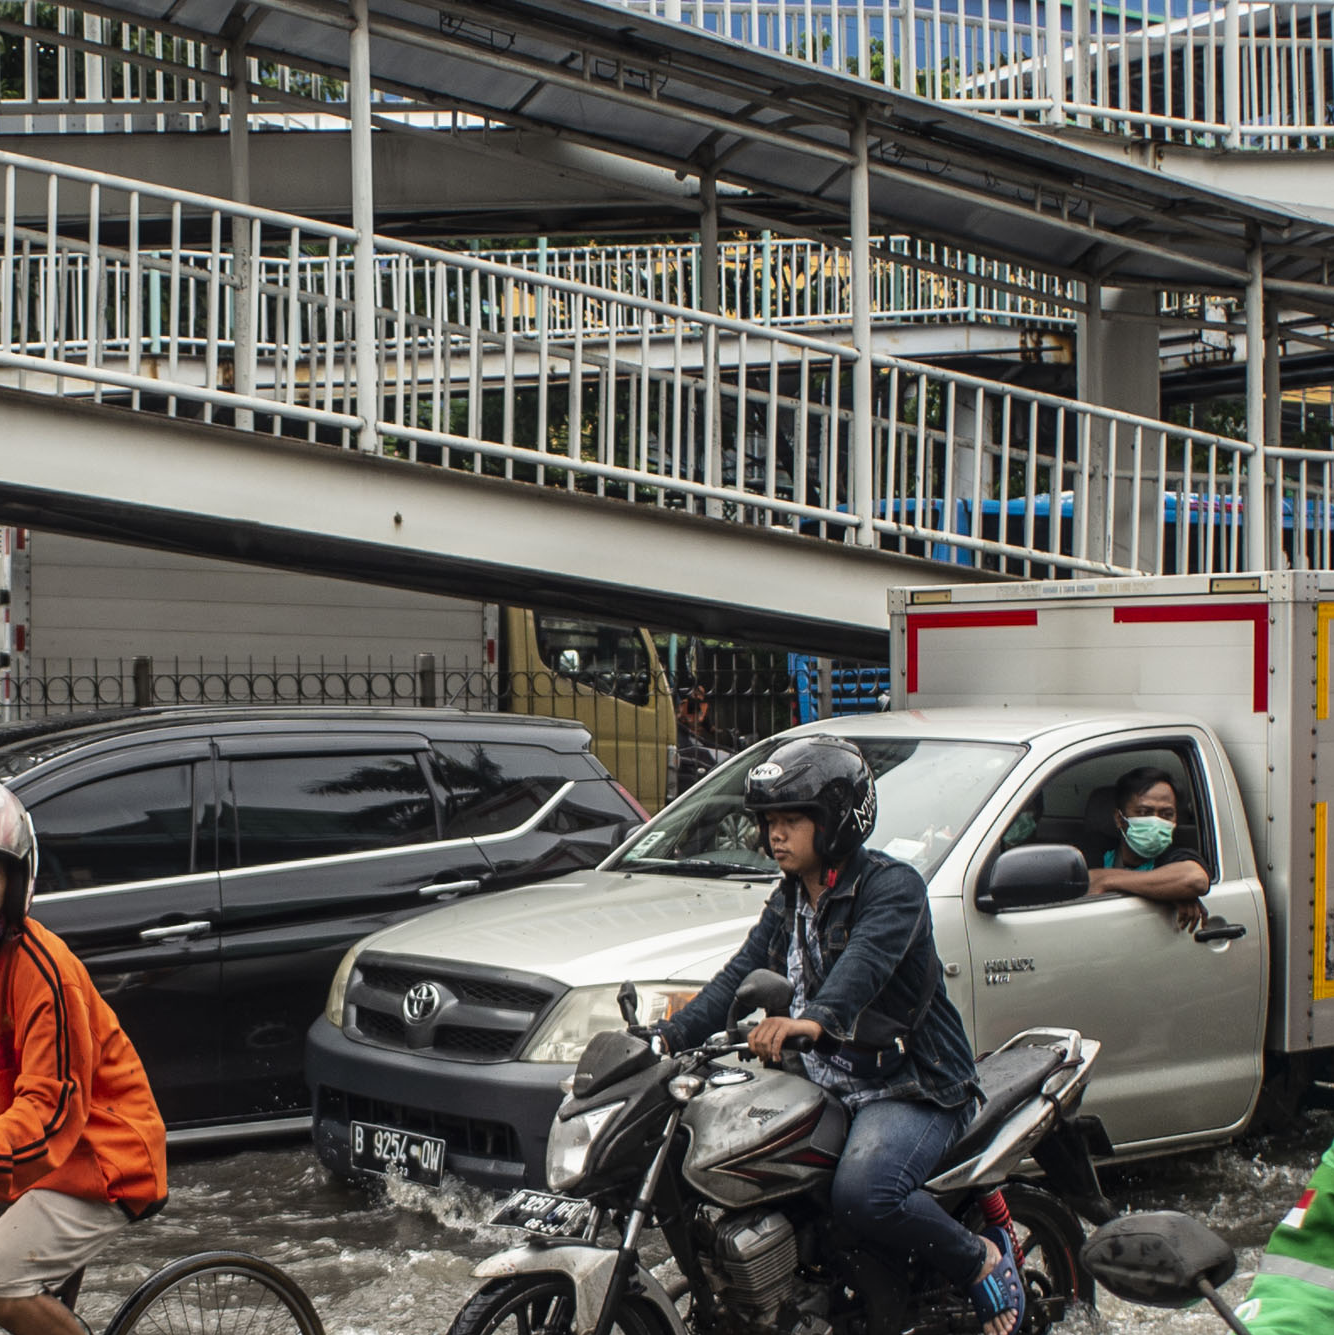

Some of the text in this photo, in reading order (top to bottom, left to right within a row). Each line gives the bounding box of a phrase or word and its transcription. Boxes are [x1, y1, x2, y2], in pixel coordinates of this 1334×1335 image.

[354, 1125, 441, 1171] B 9254 QW
